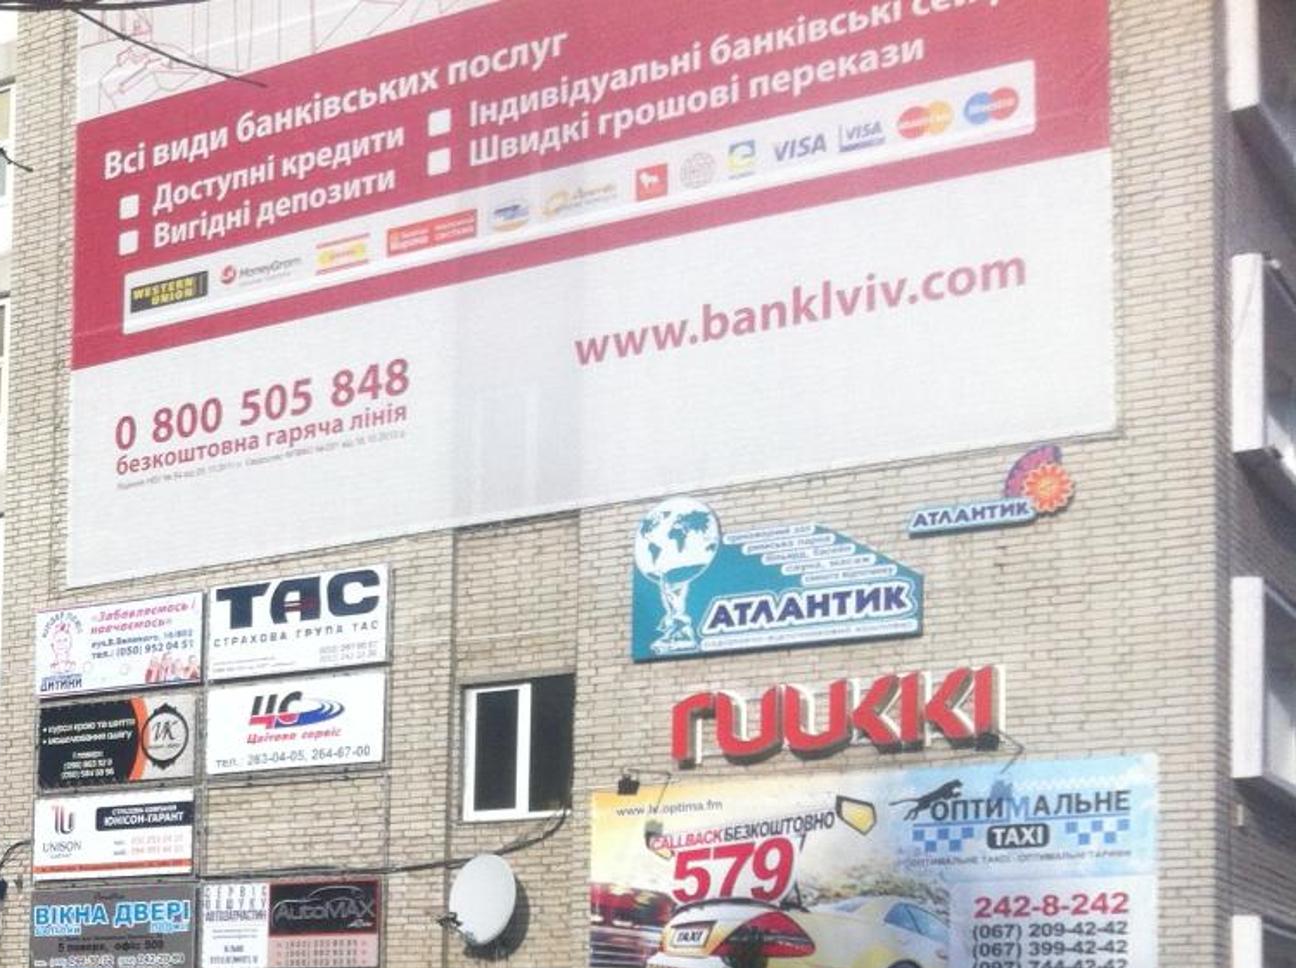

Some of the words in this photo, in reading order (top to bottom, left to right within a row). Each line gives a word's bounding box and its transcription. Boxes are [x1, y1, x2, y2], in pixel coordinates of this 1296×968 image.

[470, 40, 701, 128] Індивідуальні
[709, 0, 901, 66] банківські
[104, 149, 146, 180] Всі
[153, 125, 228, 168] види
[236, 68, 438, 144] банківських
[448, 32, 567, 92] послуг
[469, 115, 589, 168] Швидкі
[597, 74, 739, 138] грошові
[748, 38, 924, 98] перекази
[845, 121, 883, 141] VISA
[774, 133, 827, 162] VISA
[153, 155, 275, 214] Доступні
[282, 127, 404, 181] кредити
[153, 202, 251, 249] Вигідні
[257, 169, 395, 227] депозити
[132, 277, 194, 300] WESTERN
[151, 288, 194, 305] UNION
[574, 256, 1026, 367] www.banklviv.com
[115, 415, 137, 450] 0
[152, 397, 223, 443] 800
[240, 378, 313, 426] 505
[330, 358, 410, 407] 848
[116, 434, 260, 476] безкоштовна
[266, 415, 344, 449] гаряча
[349, 402, 408, 431] лінія
[912, 499, 1031, 528] АТЛАНТИК
[216, 569, 380, 630] ТАС
[707, 583, 908, 630] АТЛАНТИК
[213, 631, 288, 648] СТРАХОВА
[296, 624, 343, 639] ГРУПА
[353, 619, 379, 633] ТАС
[930, 789, 1132, 823] ОПТИМАЛЬНЕ
[724, 811, 835, 841] БЕЗКОШТОВНО
[992, 826, 1044, 847] TAXI
[671, 837, 794, 903] 579
[34, 903, 109, 927] ВІКНА
[113, 900, 191, 928] ДВЕРІ
[973, 892, 1130, 918] 242-8-242
[972, 924, 1022, 941] (067)
[1028, 921, 1129, 937] 209-42-42
[972, 942, 1022, 960] (067)
[1028, 940, 1129, 956] 399-42-42
